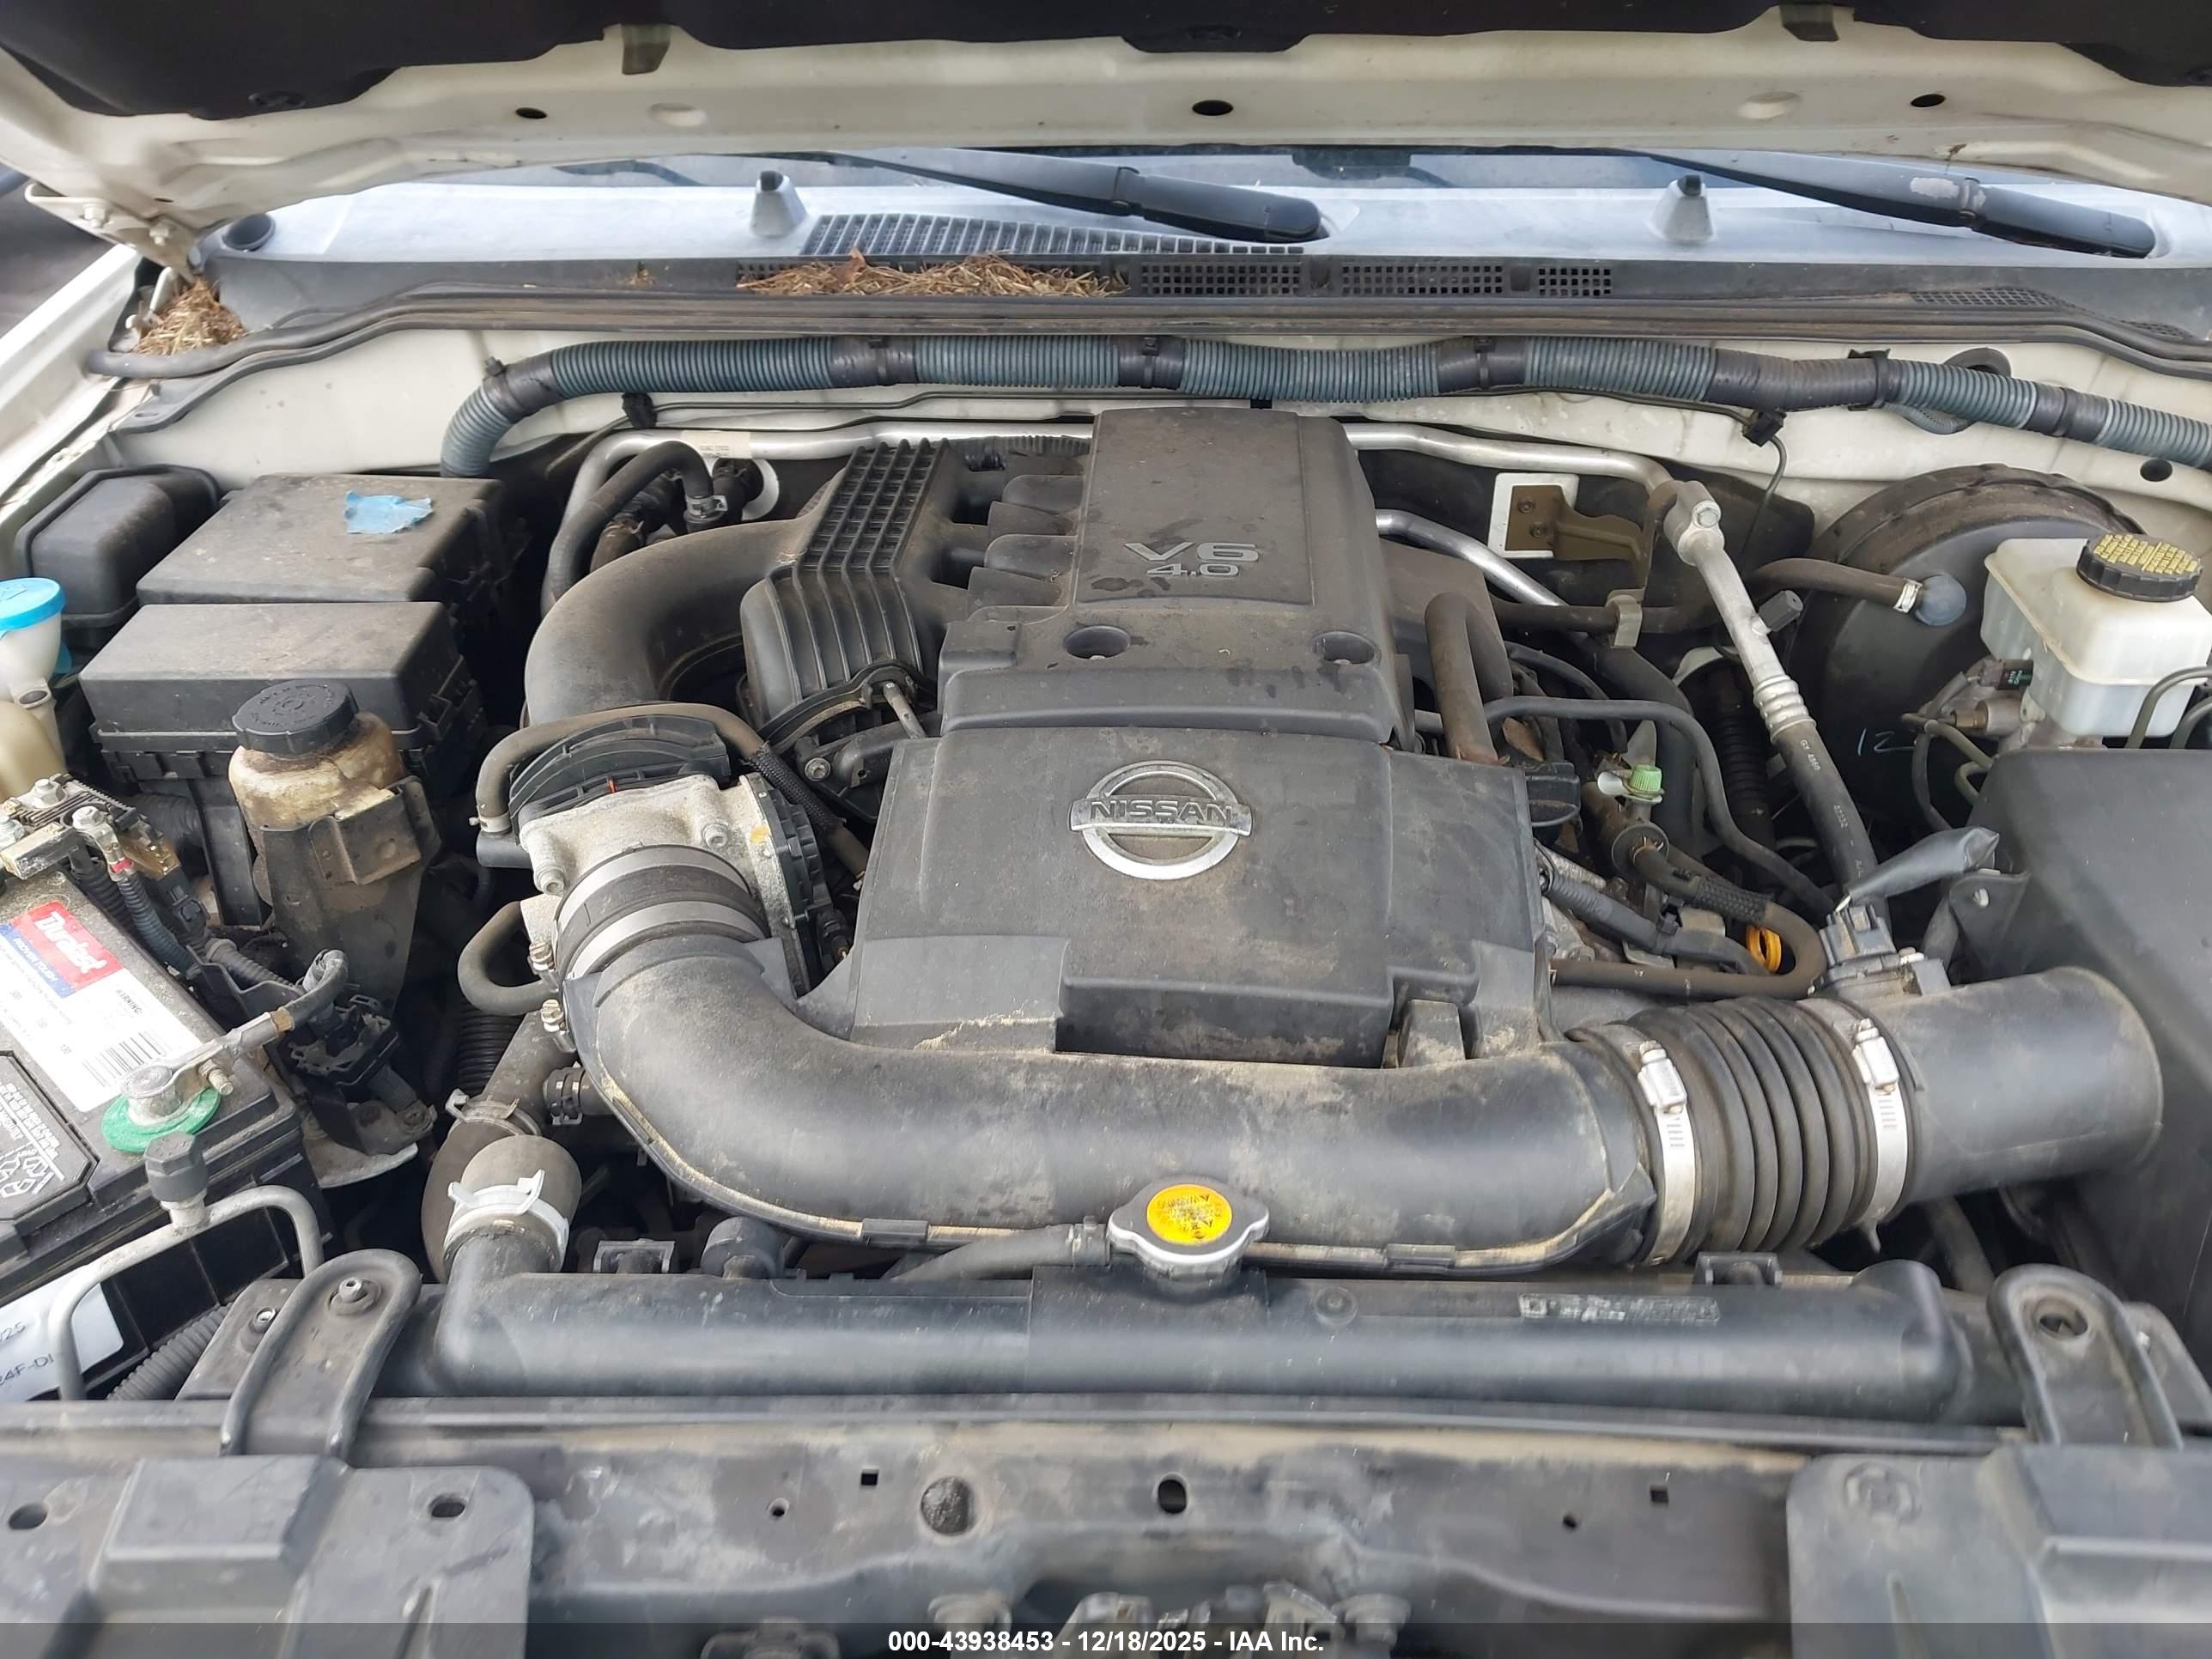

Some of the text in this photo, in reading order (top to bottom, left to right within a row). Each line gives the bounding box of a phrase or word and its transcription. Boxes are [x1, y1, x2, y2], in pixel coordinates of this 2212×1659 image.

[1124, 541, 1259, 562] V6
[1146, 562, 1239, 577] 4.0
[1090, 799, 1233, 825] NISSAN
